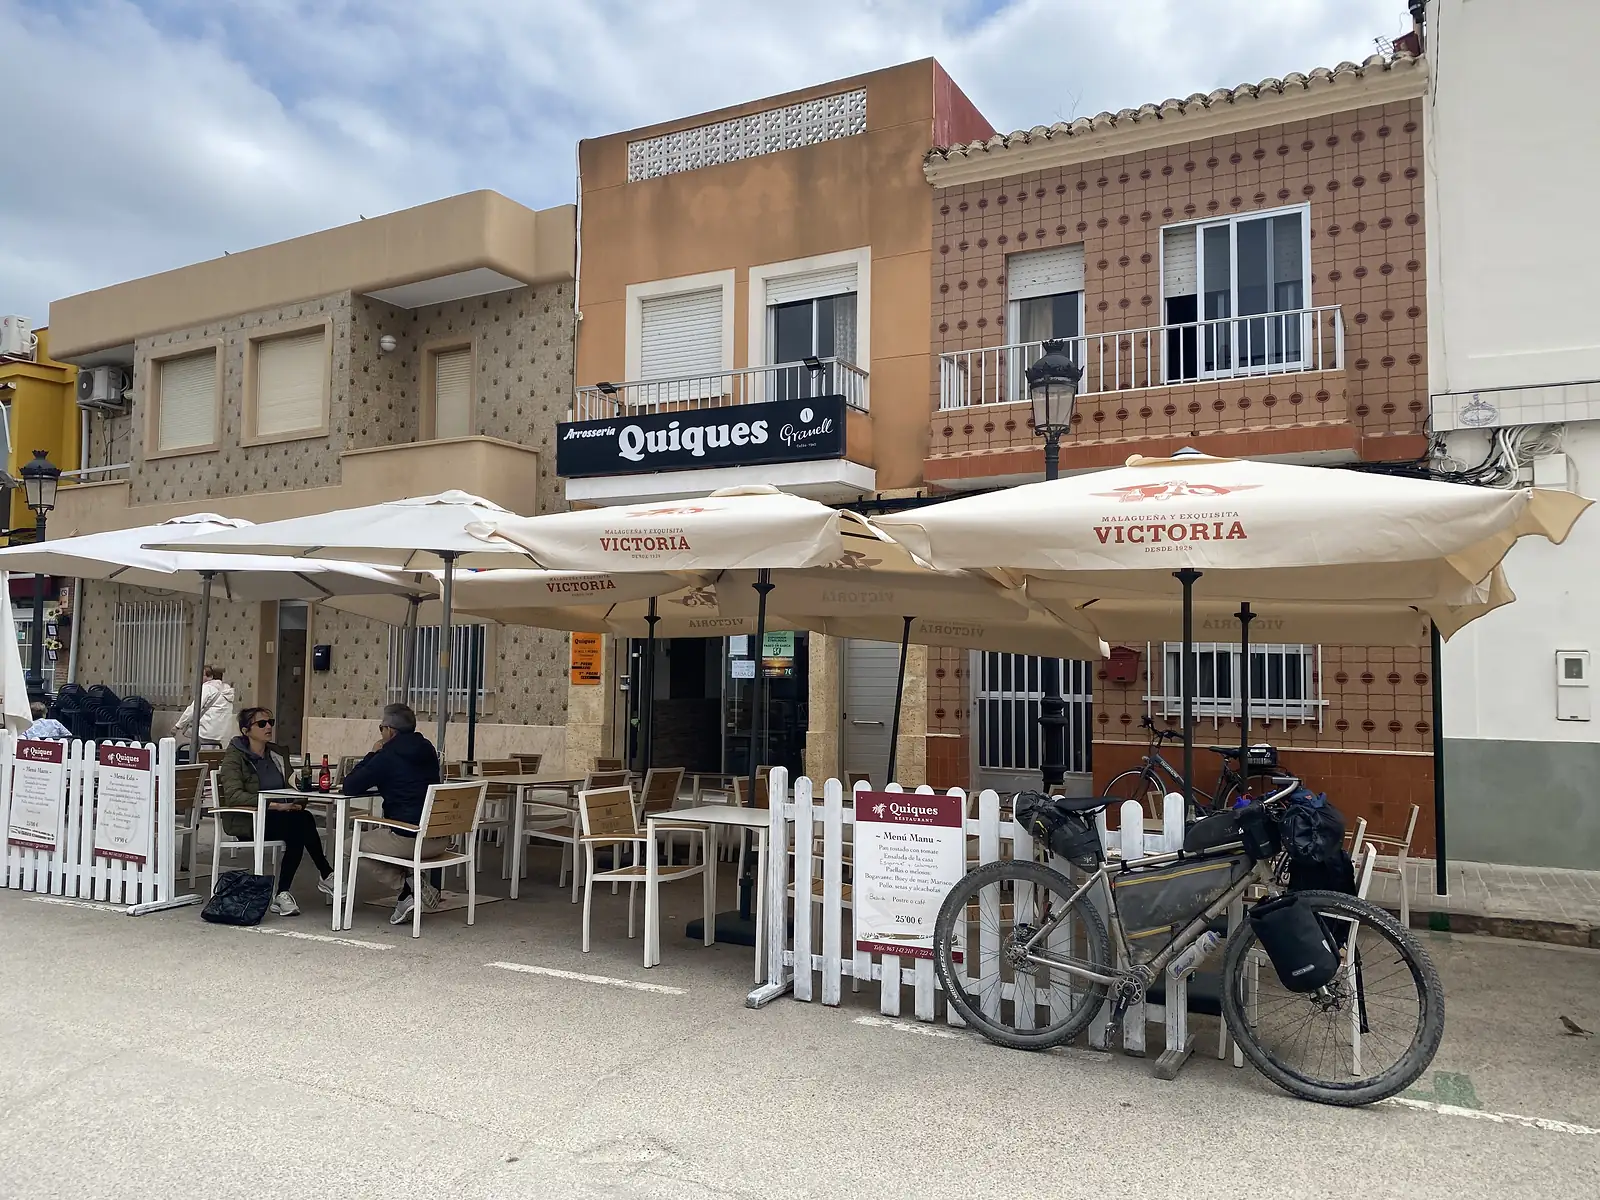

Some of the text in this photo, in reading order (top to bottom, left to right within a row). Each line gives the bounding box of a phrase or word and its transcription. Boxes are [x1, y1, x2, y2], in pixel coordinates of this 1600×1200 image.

[779, 418, 834, 447] Granell
[618, 420, 769, 462] Quiques
[1102, 514, 1167, 522] MALAGUEÑA
[1179, 511, 1240, 520] EXQUISITA
[649, 527, 684, 535] EXQUISITA
[1093, 521, 1248, 544] VICTORIA
[599, 536, 691, 552] VICTORIA
[546, 579, 616, 593] VICTORIA
[30, 746, 53, 757] Quiques
[115, 752, 140, 763] Quiques
[889, 802, 939, 817] Quiques
[883, 831, 934, 843] Menú Manu
[883, 852, 908, 860] Ensalada
[912, 883, 941, 893] alcachofas
[892, 896, 909, 904] Postre
[895, 915, 923, 925] 25'00 €
[1340, 903, 1407, 948] vittoria MEZCAL
